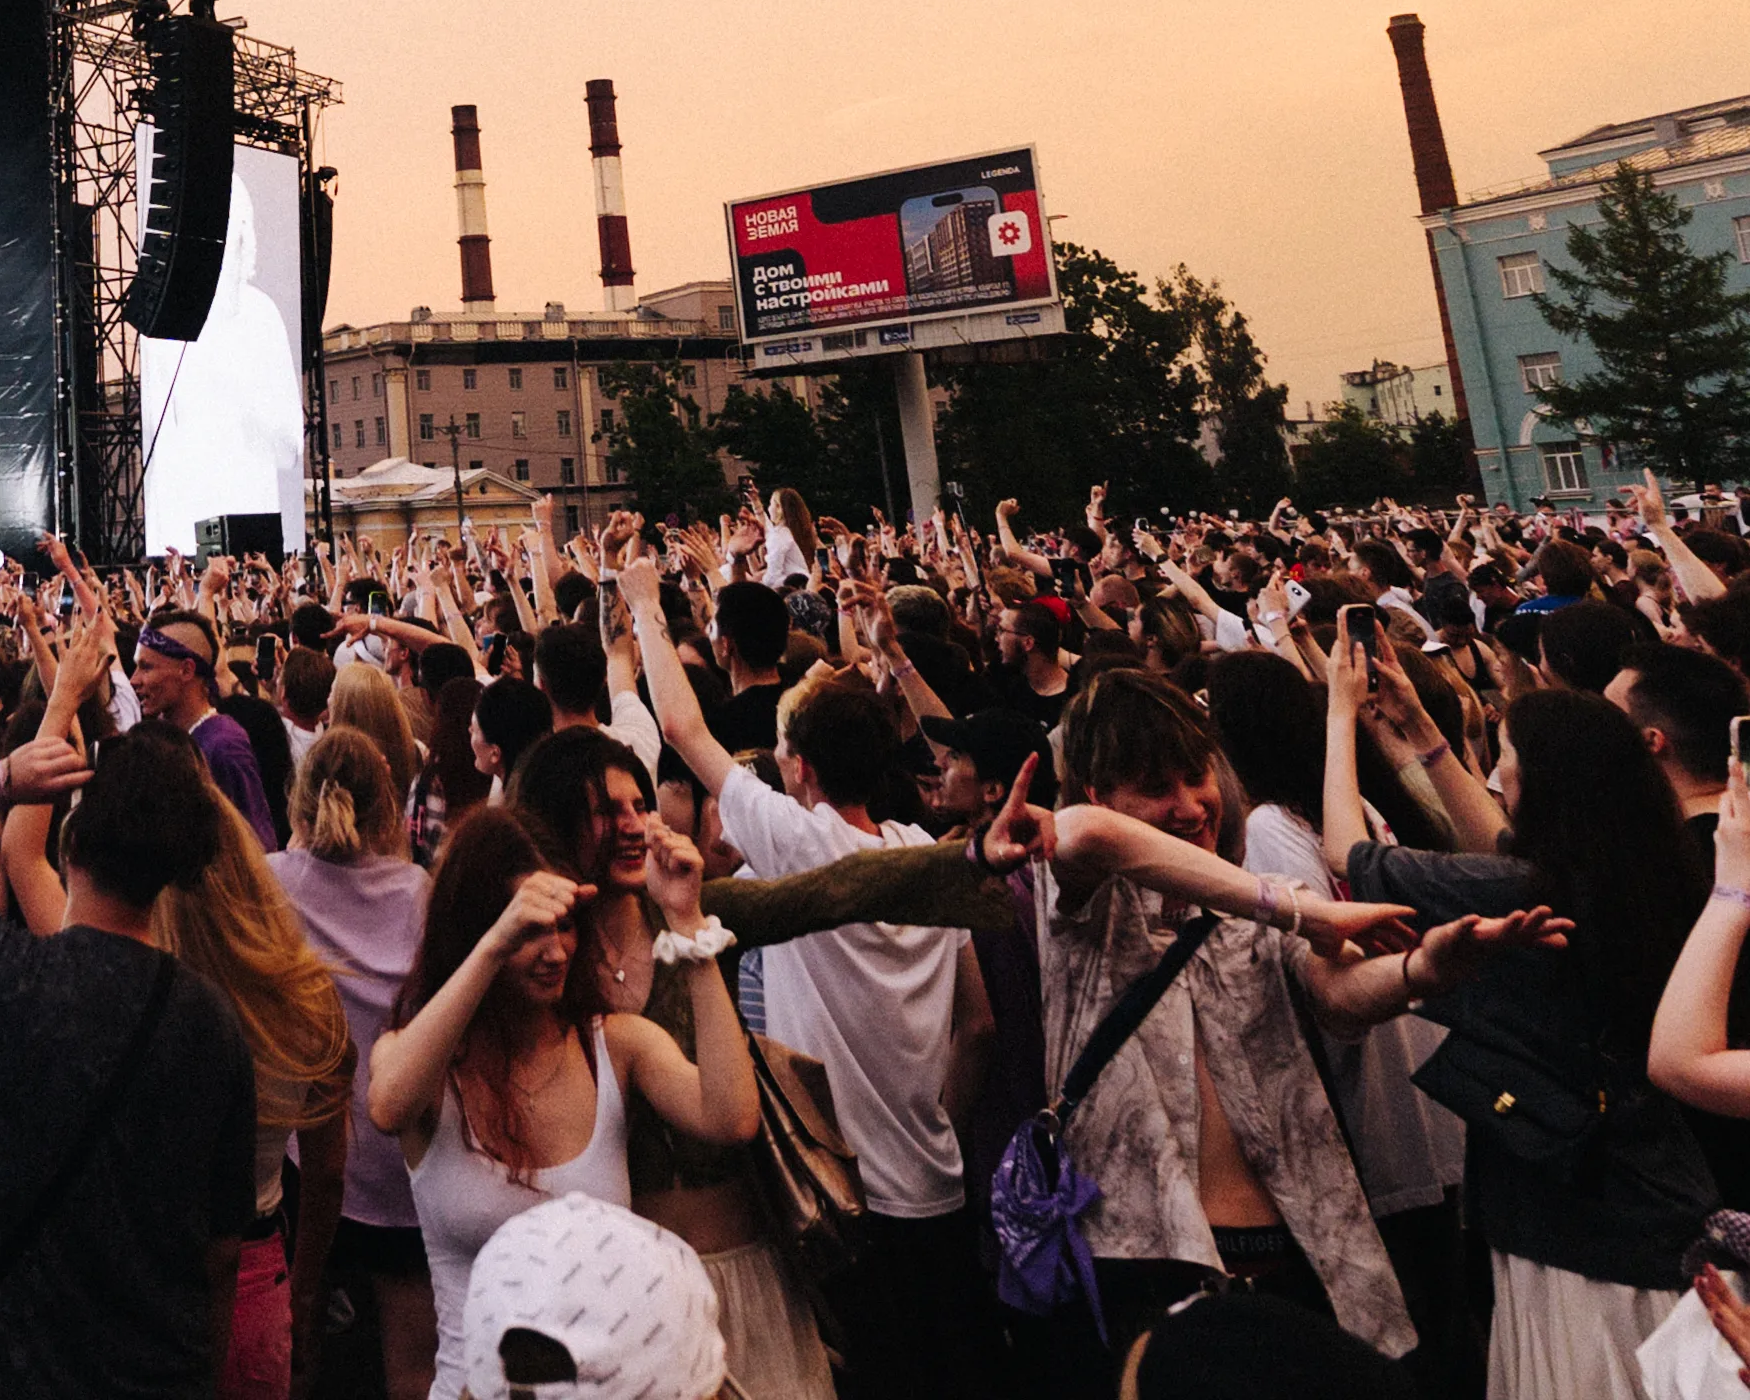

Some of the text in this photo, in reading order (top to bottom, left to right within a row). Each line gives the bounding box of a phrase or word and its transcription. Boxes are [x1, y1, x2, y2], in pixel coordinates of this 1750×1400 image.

[745, 205, 798, 228] НОВАЯ
[747, 219, 799, 241] ЗЕМЛЯ
[752, 263, 794, 284] Дом
[768, 271, 843, 294] твоими
[755, 279, 890, 312] настройками
